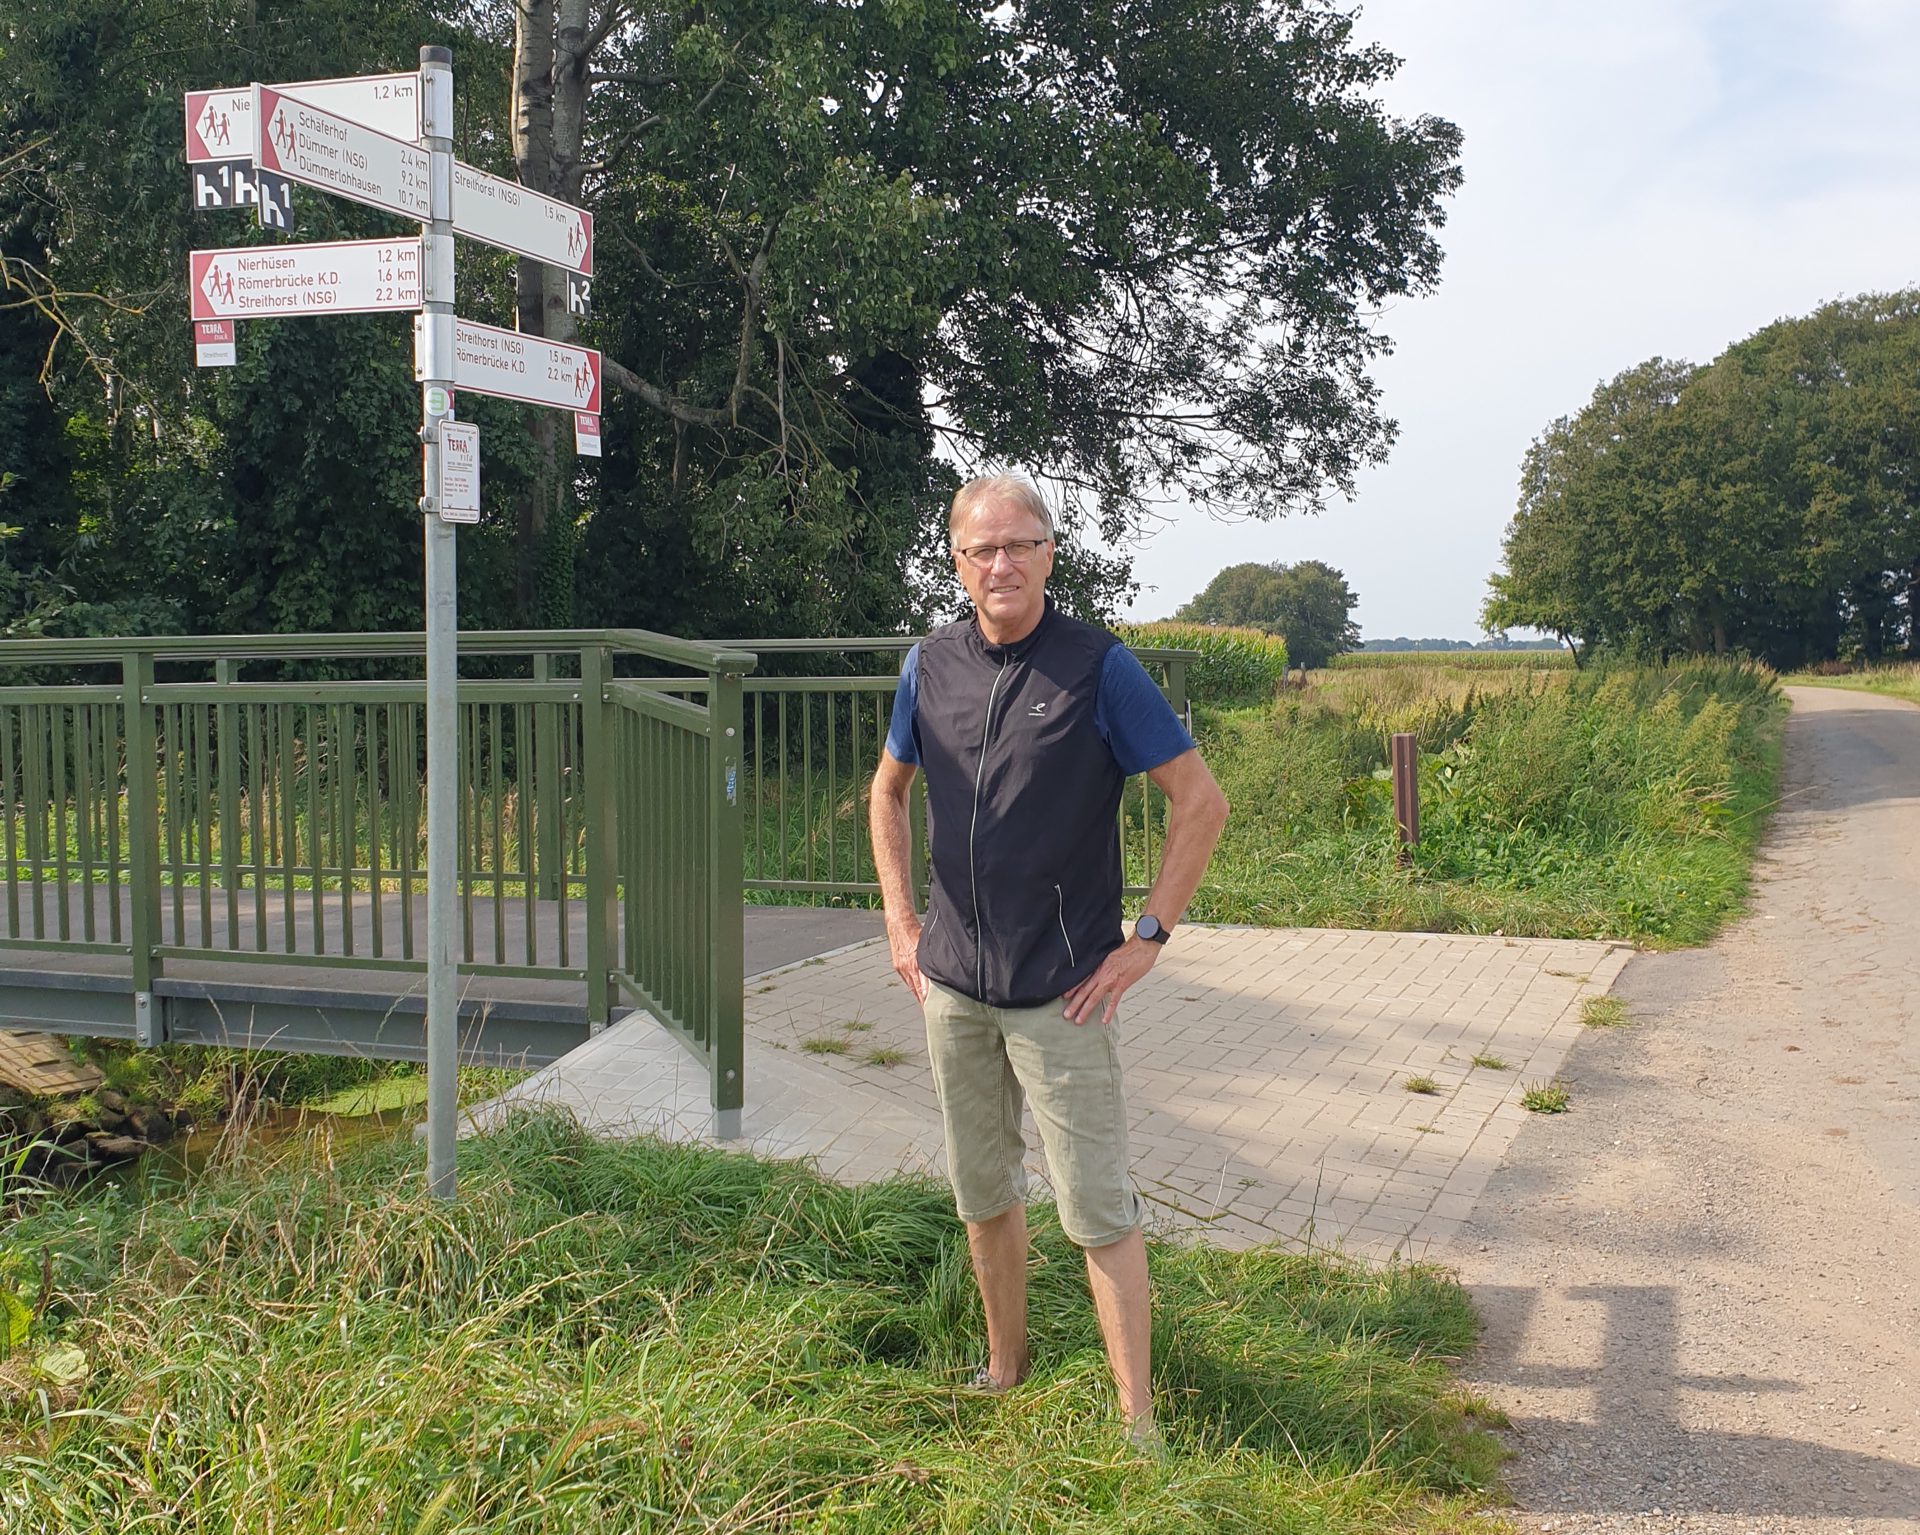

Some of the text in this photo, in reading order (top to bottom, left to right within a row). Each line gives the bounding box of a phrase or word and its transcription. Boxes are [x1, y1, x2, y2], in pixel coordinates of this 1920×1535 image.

[394, 84, 413, 98] km
[299, 111, 347, 142] Schäferhof
[299, 133, 368, 171] Dümmer (NSG)
[415, 155, 428, 172] km
[299, 155, 382, 195] Dümmerlohhausen
[415, 175, 428, 192] km
[454, 171, 520, 207] Streithorst (NSG)
[416, 195, 428, 212] km
[556, 209, 567, 224] km
[397, 248, 416, 261] km
[237, 256, 296, 271] Nierhüsen
[238, 271, 342, 290] Römerbrücke K.D.
[397, 267, 416, 281] km
[239, 289, 337, 308] Streithorst (NSG)
[398, 286, 416, 300] km
[456, 328, 524, 355] Streithorst (NSG)
[456, 347, 509, 370] Römerbrücke
[561, 352, 573, 366] km
[561, 369, 573, 383] km
